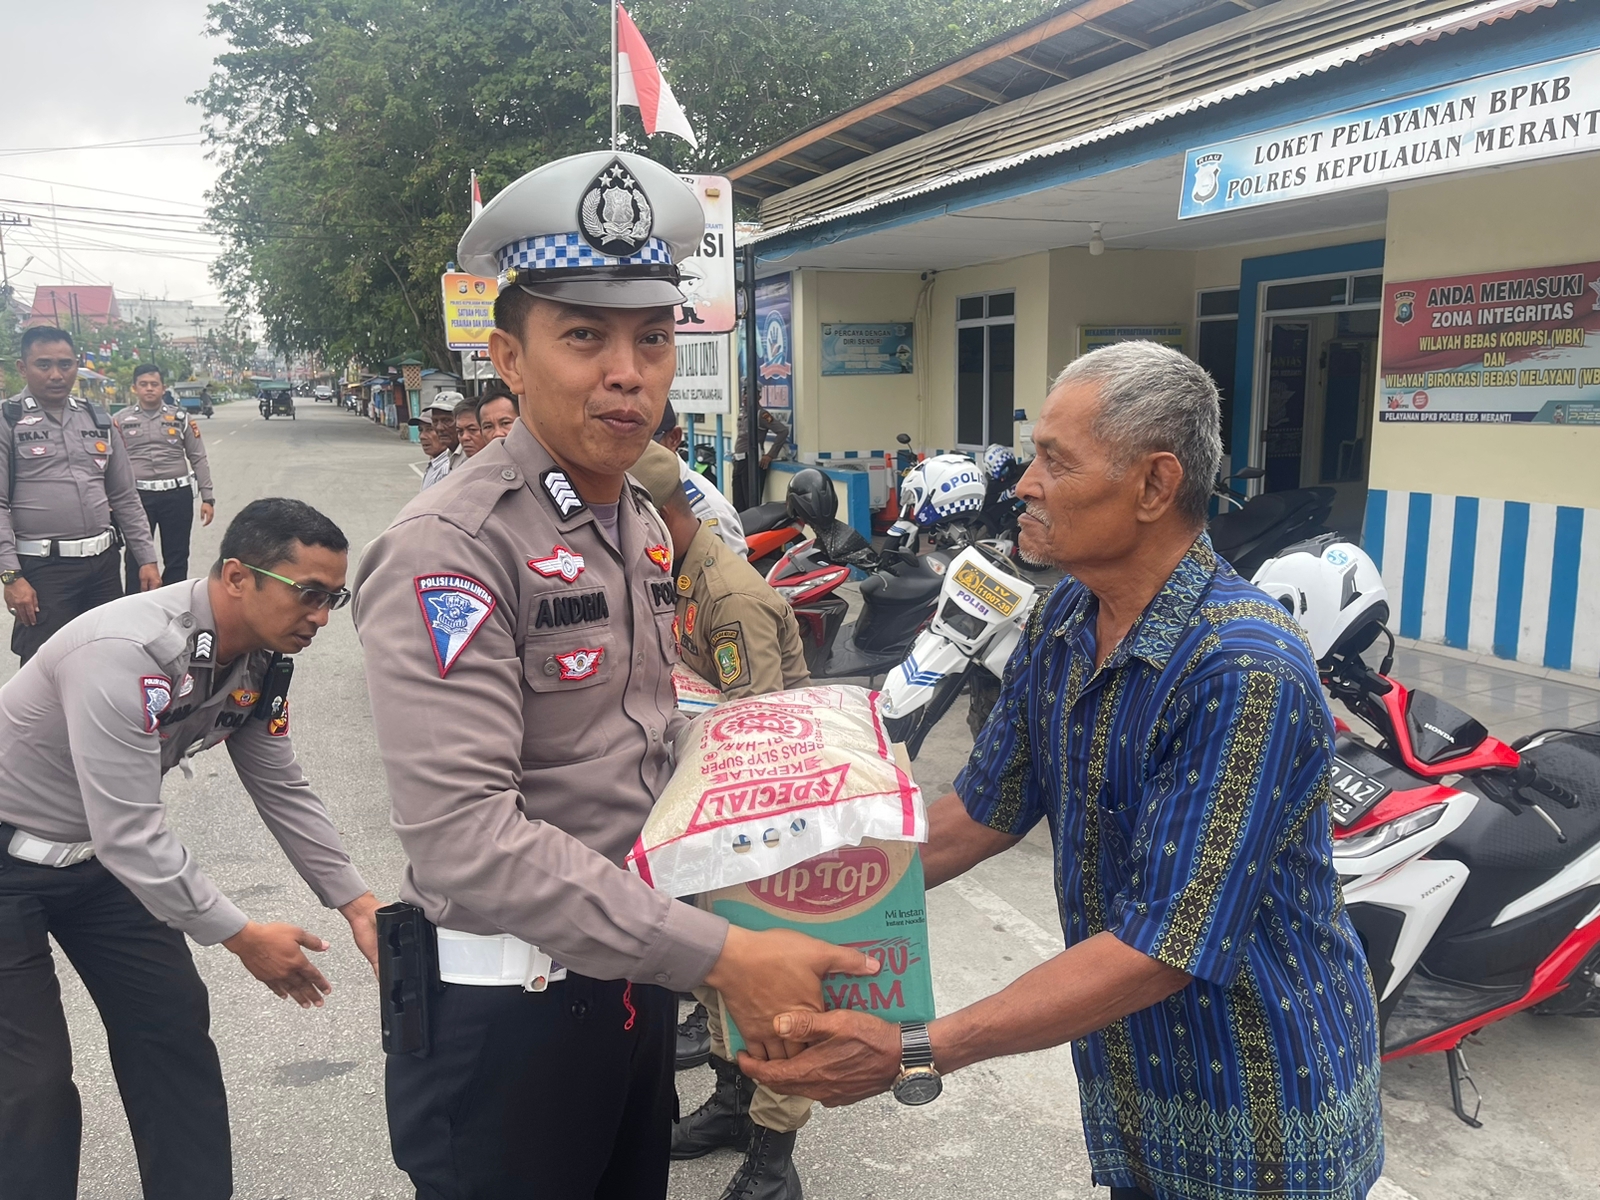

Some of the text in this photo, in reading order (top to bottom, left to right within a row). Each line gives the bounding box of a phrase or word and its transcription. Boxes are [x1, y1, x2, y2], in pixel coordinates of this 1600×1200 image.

[1254, 76, 1570, 165] LOKET PELAYANAN BPKB
[1227, 166, 1306, 199] POLRES
[1316, 135, 1462, 182] KEPULAUAN
[1427, 274, 1584, 307] ANDA MEMASUKI
[1432, 302, 1574, 328] ZONA INTEGRITAS
[834, 329, 891, 337] PERCAYA DENGAN
[1420, 328, 1585, 351] WILAYAH BEBAS KORUPSI (WBK)
[1483, 352, 1505, 367] DAN
[1385, 373, 1425, 388] WILAYAH
[1427, 371, 1480, 387] BIROKRASI
[1482, 370, 1517, 387] BEBAS
[1519, 369, 1575, 386] MELAYANI
[1385, 412, 1420, 421] PELAYANAN
[1421, 412, 1437, 421] BPKB
[1438, 412, 1463, 421] POLRES
[1481, 413, 1511, 422] MERANTI
[420, 576, 493, 604] POLISI LALU LINTAS
[994, 585, 1010, 597] IV
[956, 590, 989, 616] POLISI
[1424, 723, 1456, 744] HONDA
[701, 756, 744, 775] SUPER
[747, 749, 780, 767] SLYP
[729, 761, 804, 780] KEPALA
[709, 776, 833, 816] SPECIAL
[1335, 774, 1376, 802] AAZ
[815, 861, 882, 897] Top
[1421, 874, 1456, 899] HONDA
[885, 908, 924, 919] Mi Instan
[886, 919, 904, 927] Instant
[824, 979, 906, 1012] YAM
